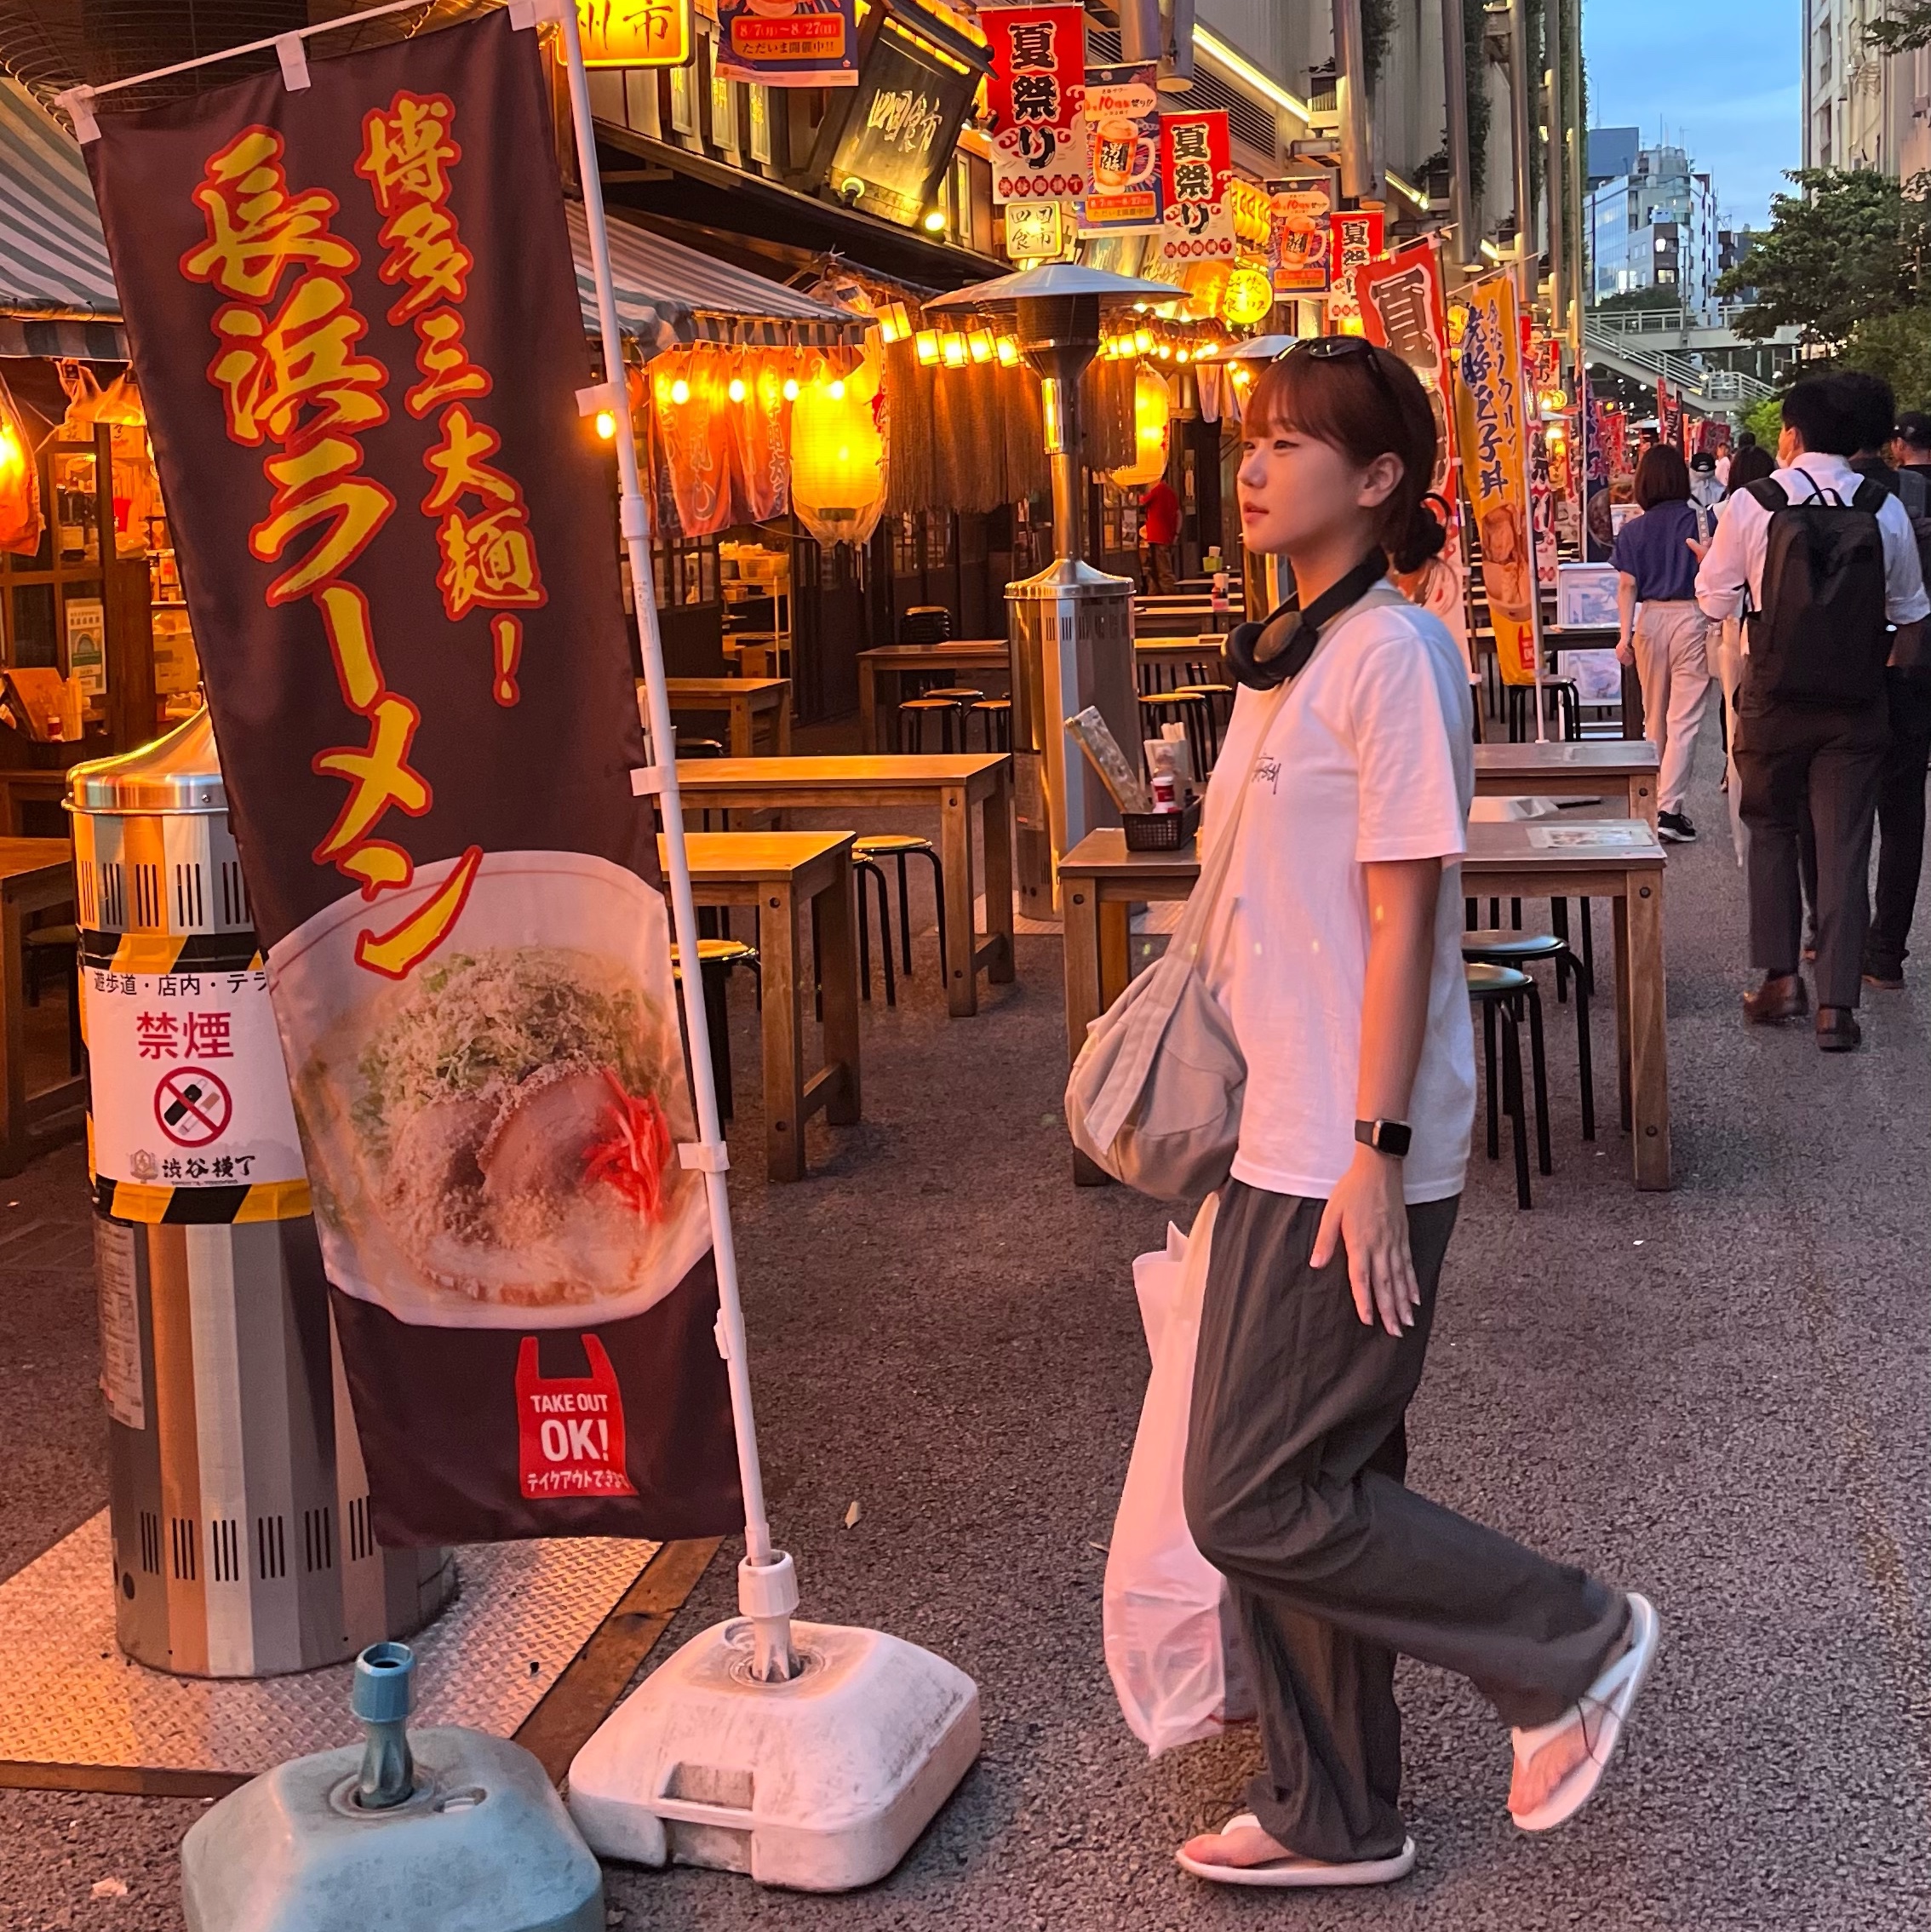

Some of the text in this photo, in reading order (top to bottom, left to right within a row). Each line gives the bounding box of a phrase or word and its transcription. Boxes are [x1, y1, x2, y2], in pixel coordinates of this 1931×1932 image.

[1008, 20, 1060, 170] 夏祭り
[1172, 123, 1211, 237] 夏祭り
[180, 124, 484, 980] 長浜ラーメン
[136, 1011, 234, 1059] 禁煙
[162, 1155, 256, 1179] 渋谷横丁
[530, 1393, 608, 1413] TAKE OUT
[540, 1419, 609, 1462] OK!
